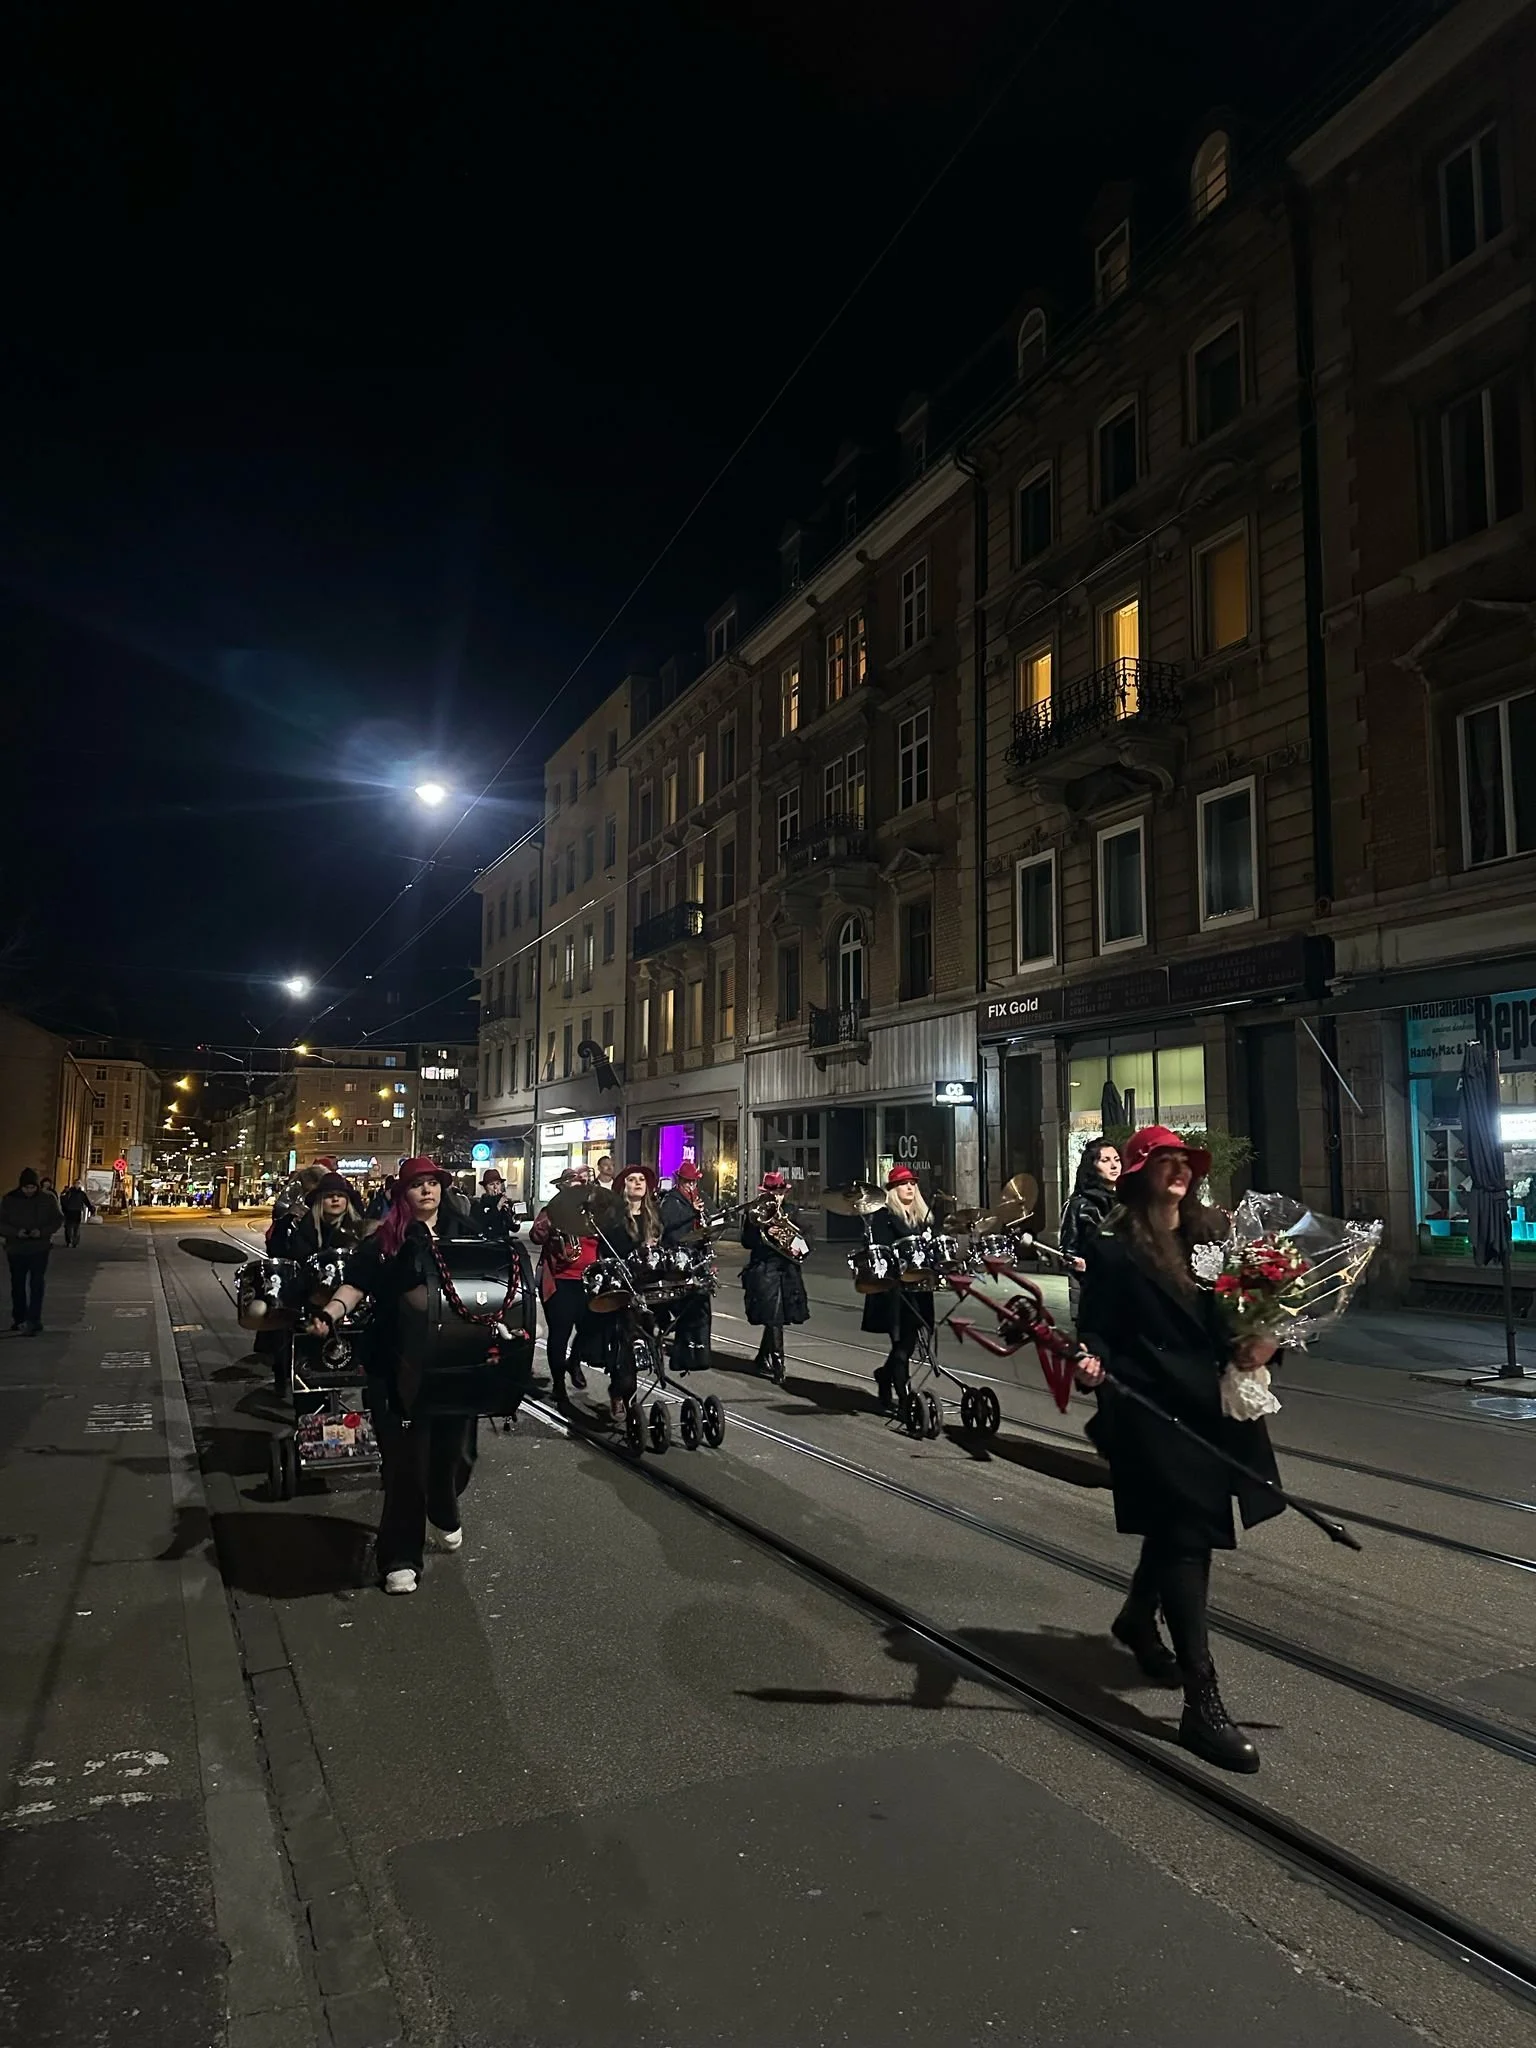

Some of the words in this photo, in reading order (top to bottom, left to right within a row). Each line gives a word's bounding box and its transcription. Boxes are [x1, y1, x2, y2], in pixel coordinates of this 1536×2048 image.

[988, 1003, 1008, 1019] FIX
[1009, 997, 1038, 1015] Gold
[1438, 1044, 1455, 1056] Mac
[898, 1135, 918, 1158] CG
